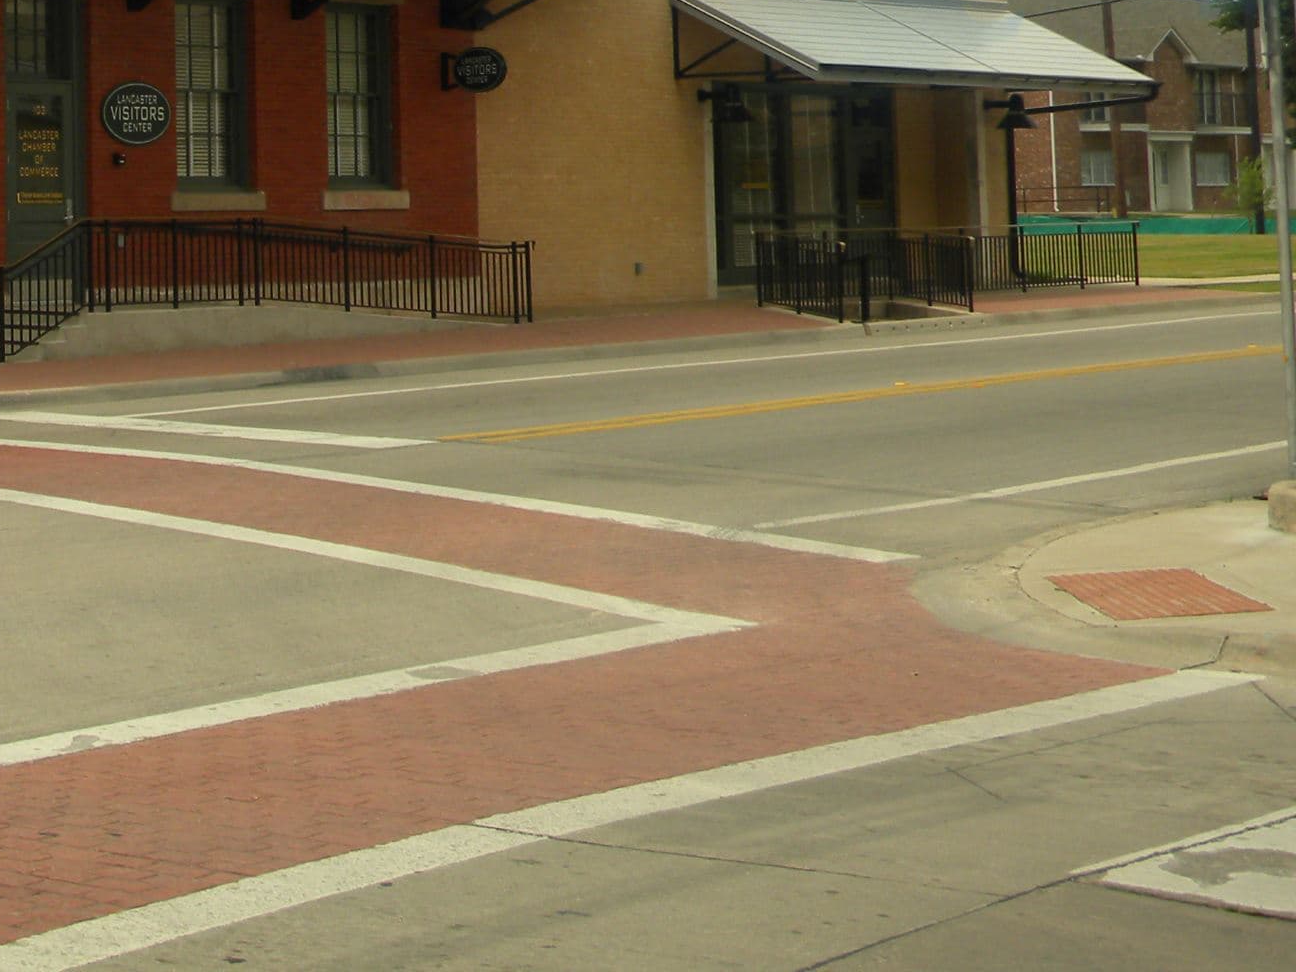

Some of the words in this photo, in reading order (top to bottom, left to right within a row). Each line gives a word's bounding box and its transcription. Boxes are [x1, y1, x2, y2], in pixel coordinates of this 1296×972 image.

[116, 94, 158, 105] LANCASTER
[110, 105, 165, 121] VISITORS
[122, 122, 153, 133] CENTER
[18, 130, 60, 141] LANCASTER
[22, 142, 57, 152] CHAMBER
[19, 166, 60, 177] COMMERCE
